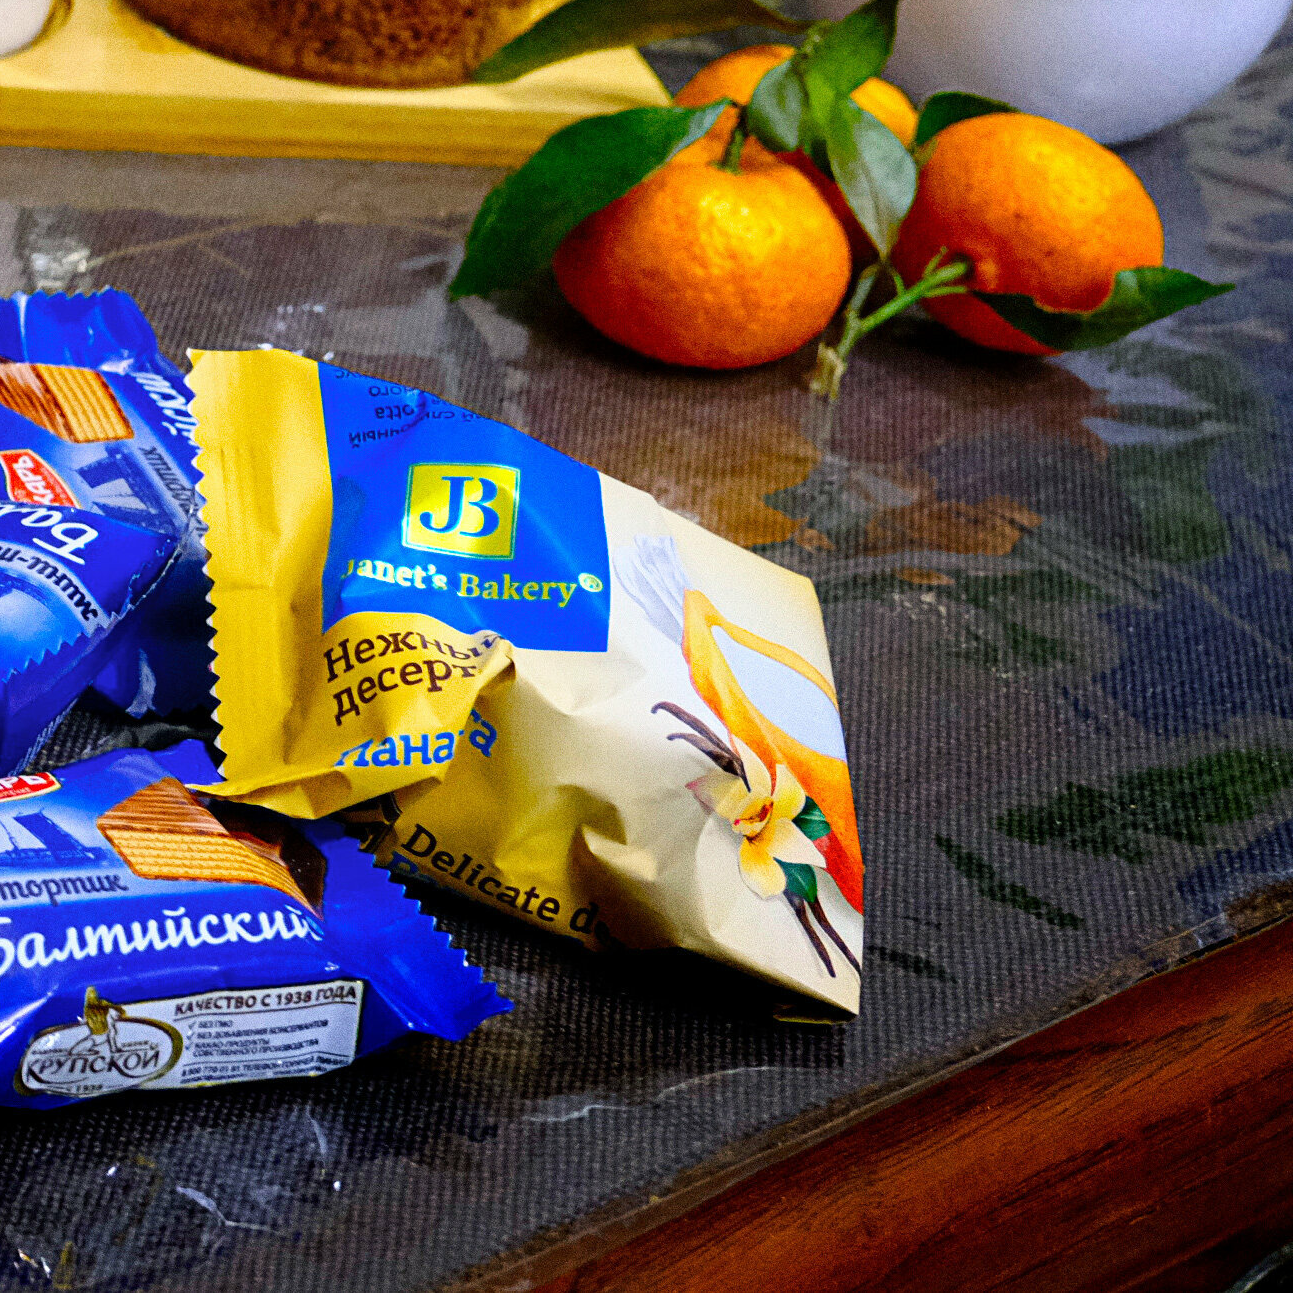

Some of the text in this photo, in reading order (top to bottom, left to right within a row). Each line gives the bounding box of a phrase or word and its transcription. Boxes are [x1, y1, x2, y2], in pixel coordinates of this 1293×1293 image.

[15, 454, 55, 506] КАРЬ
[457, 572, 578, 609] Bakery
[332, 658, 478, 727] десерт
[400, 823, 561, 923] Delicate
[174, 993, 257, 1017] КАЧЕСТВО
[275, 989, 313, 1006] 1938
[315, 984, 357, 1002] ГОДА
